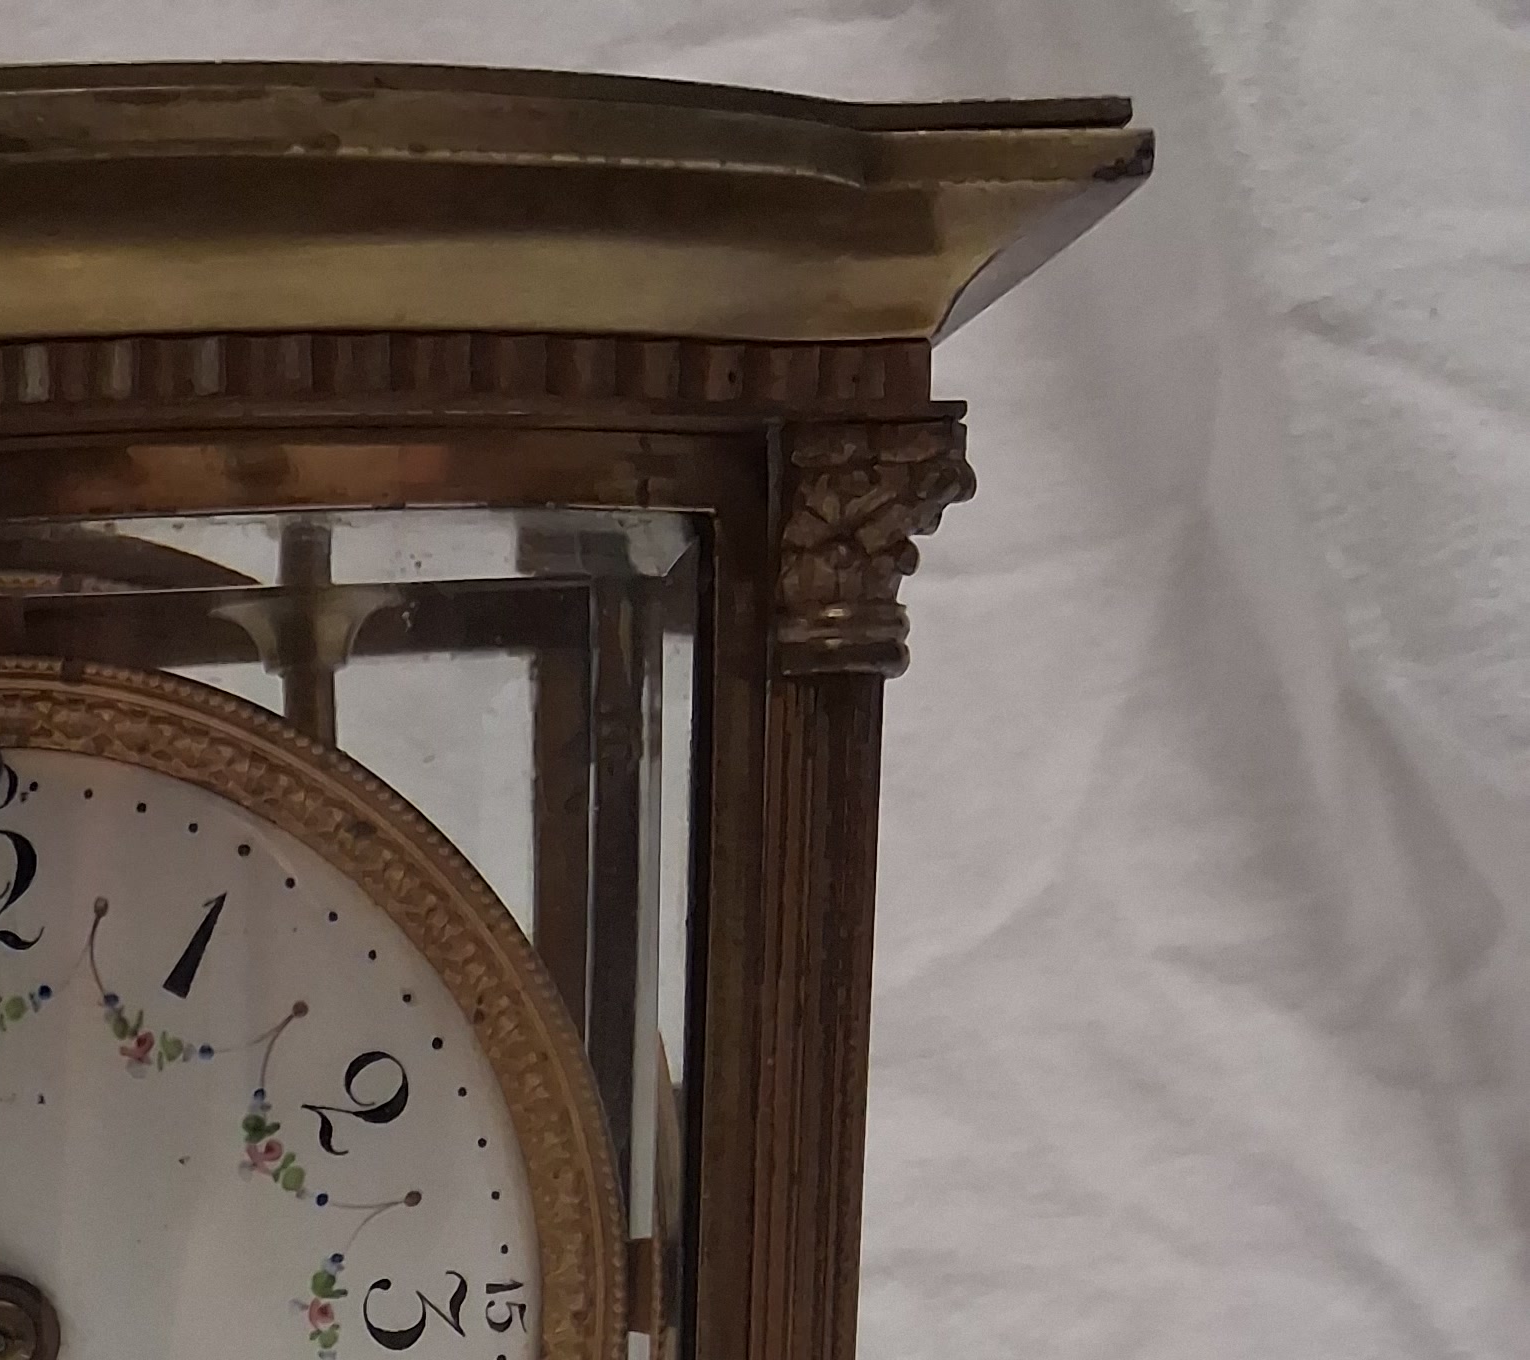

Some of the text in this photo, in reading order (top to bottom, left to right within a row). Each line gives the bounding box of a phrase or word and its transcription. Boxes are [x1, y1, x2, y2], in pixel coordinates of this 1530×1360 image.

[163, 892, 227, 999] 1
[302, 1051, 408, 1156] 2
[363, 1270, 467, 1350] 3
[485, 1278, 527, 1333] 15
